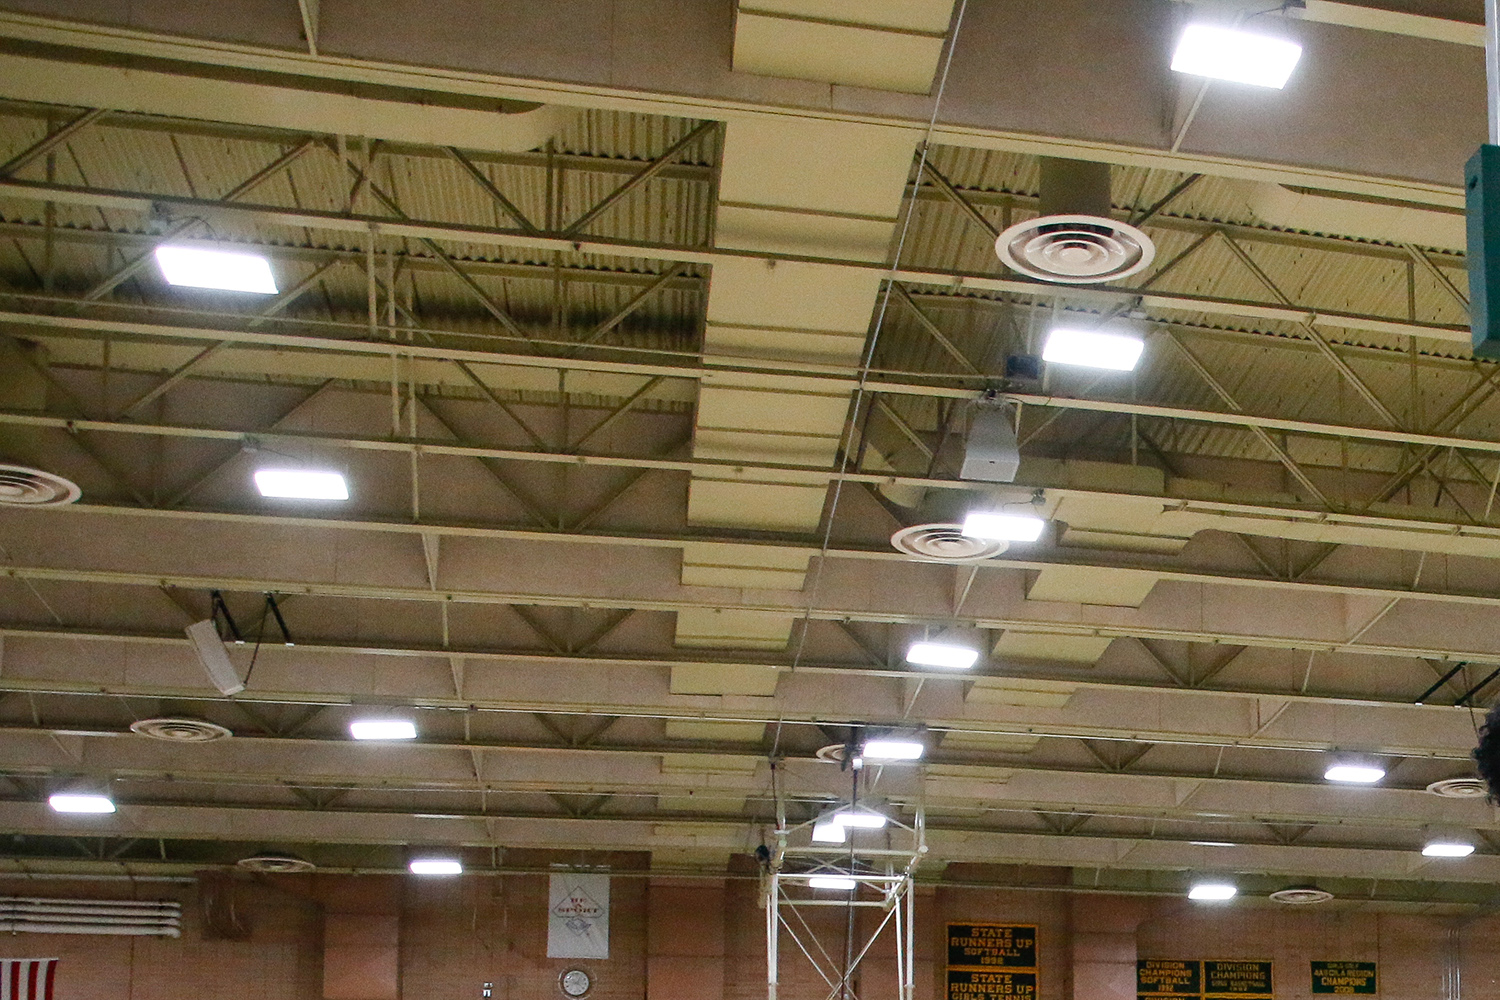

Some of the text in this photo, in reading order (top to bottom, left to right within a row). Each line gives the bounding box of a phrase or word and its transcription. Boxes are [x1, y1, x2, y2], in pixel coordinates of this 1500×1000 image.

[971, 928, 1012, 938] STATE
[951, 937, 1033, 948] RUNNERS UP
[964, 948, 1020, 957] SOFTBALL
[1146, 961, 1185, 969] DIVISION
[1139, 969, 1192, 977] CHAMPIONS
[1211, 971, 1266, 979] CHAMPIONS
[971, 974, 1012, 984] STATE
[1140, 977, 1190, 985] SOFTBALL
[1321, 977, 1366, 986] CHAMPIONS
[950, 983, 1034, 994] RUNNERS UP
[952, 993, 985, 1000] GIRLS
